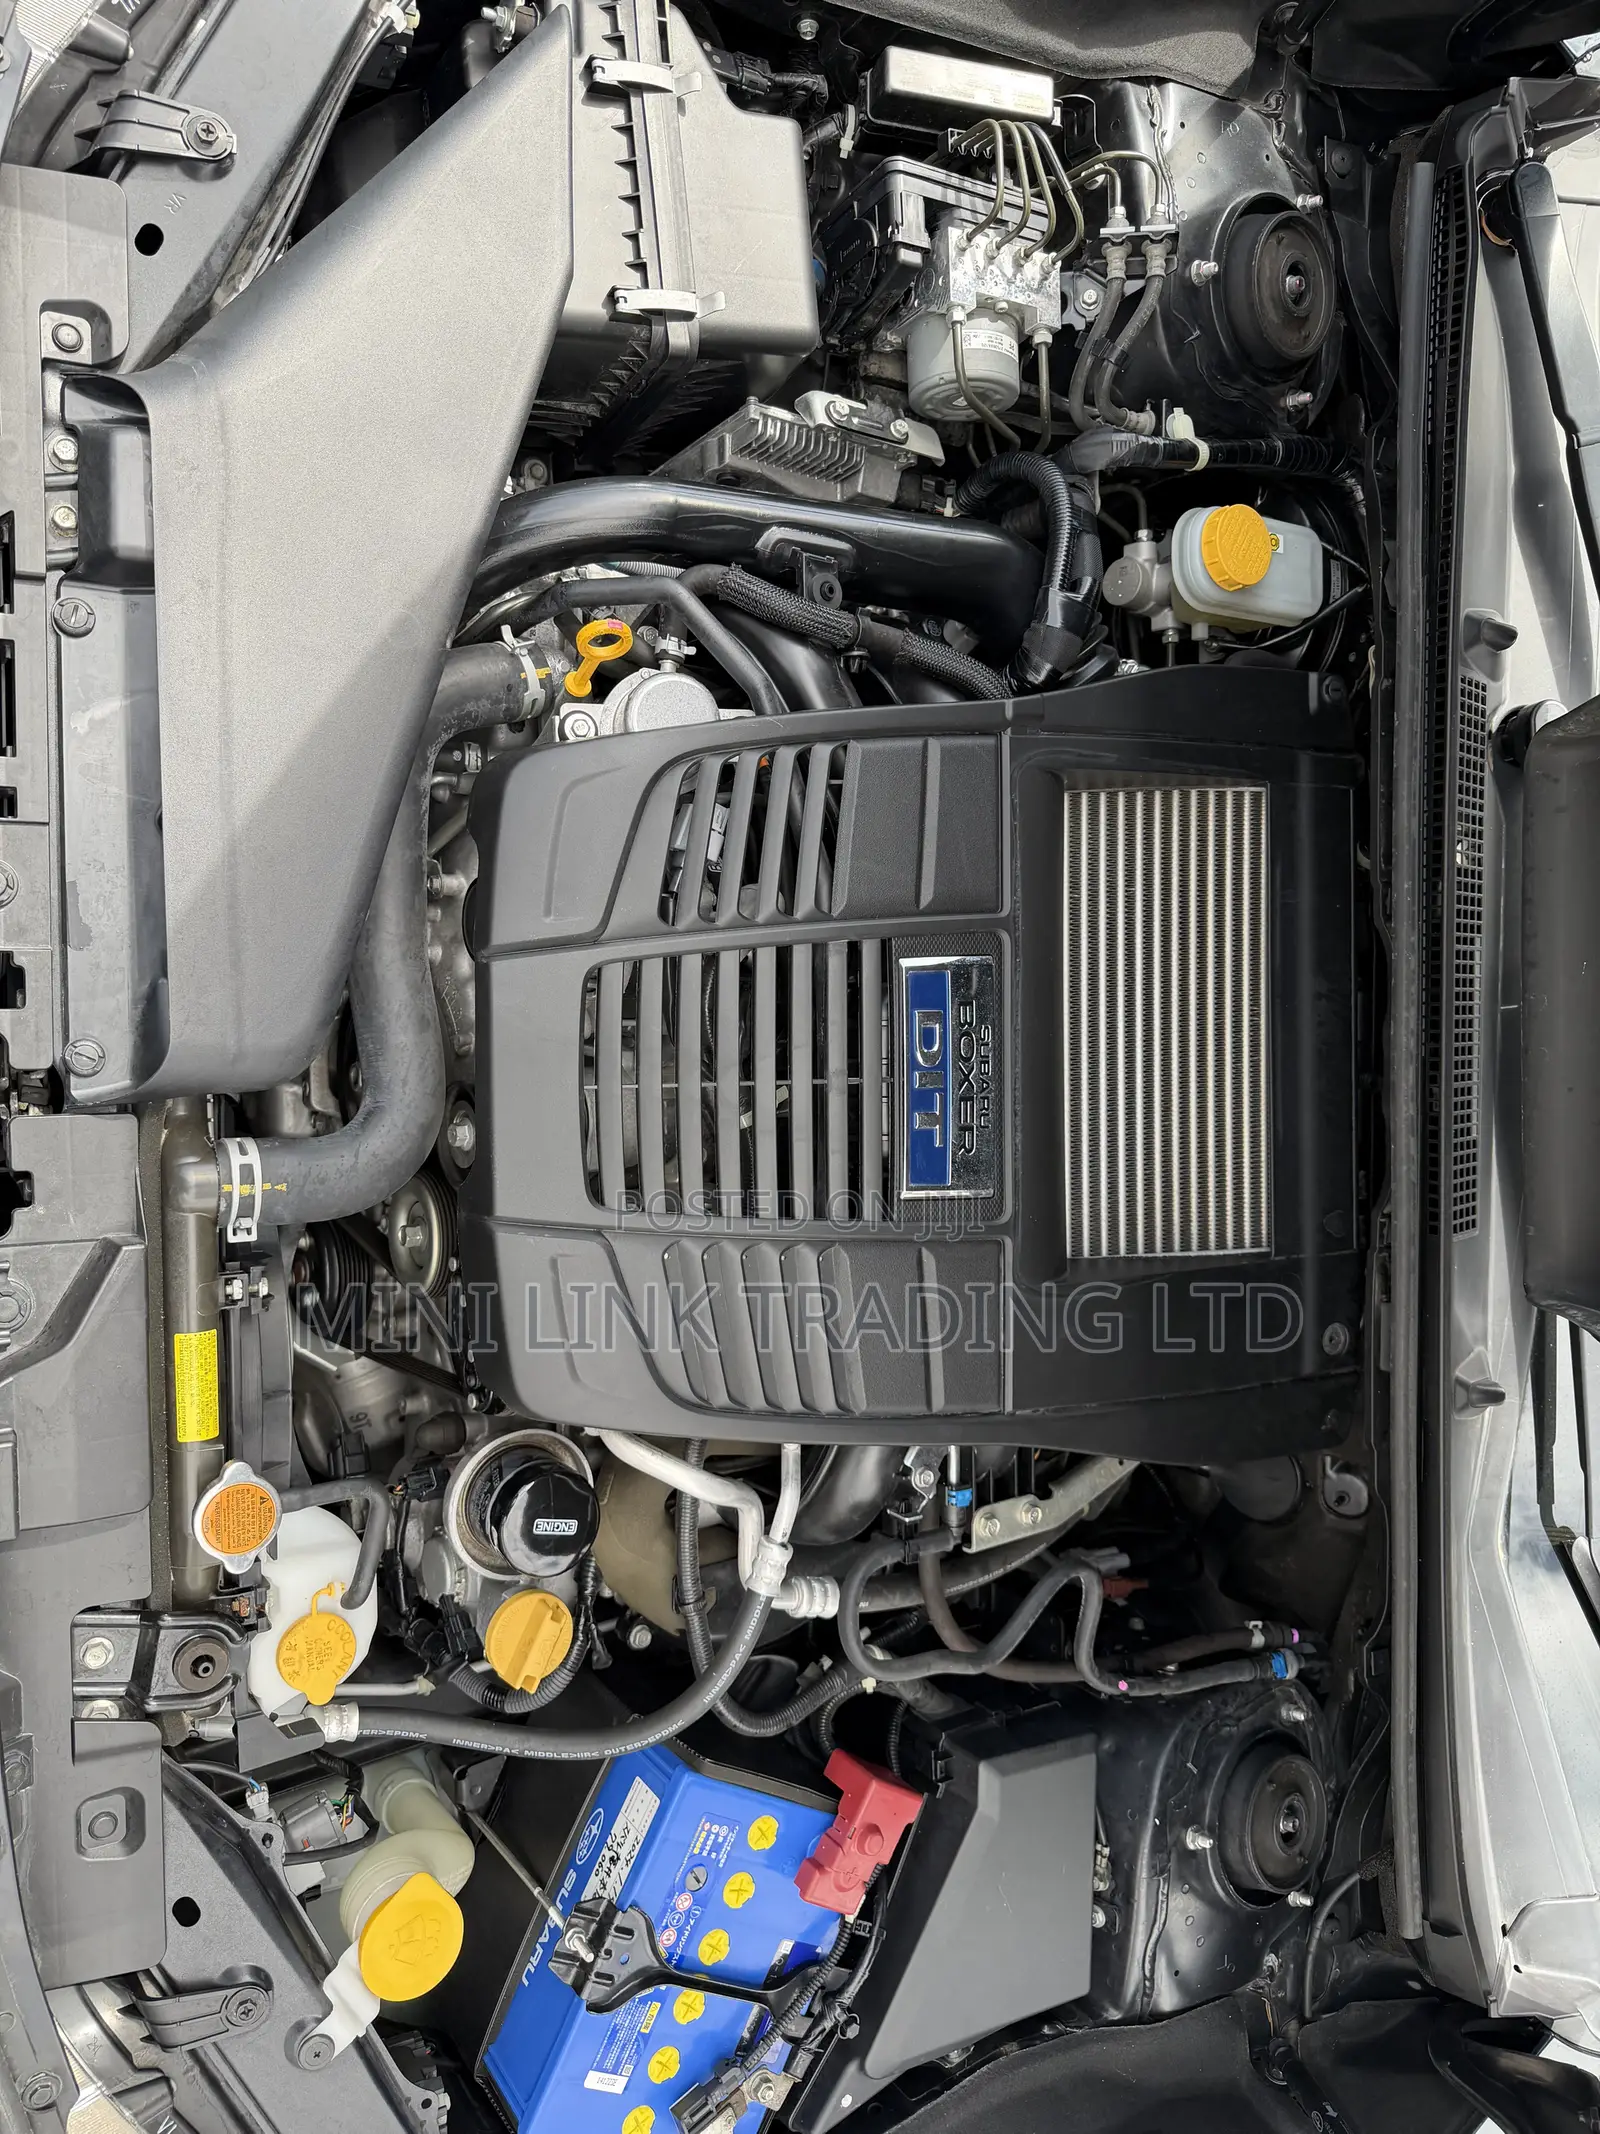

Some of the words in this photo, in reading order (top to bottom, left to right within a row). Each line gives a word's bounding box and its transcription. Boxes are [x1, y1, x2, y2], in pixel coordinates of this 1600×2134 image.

[913, 1009, 944, 1148] DIT
[957, 999, 977, 1156] BOXER
[979, 1024, 992, 1129] SUBARU
[536, 1521, 576, 1533] ENGINE
[326, 1618, 353, 1680] COOLANT
[671, 1918, 695, 1969] アイドリングスト
